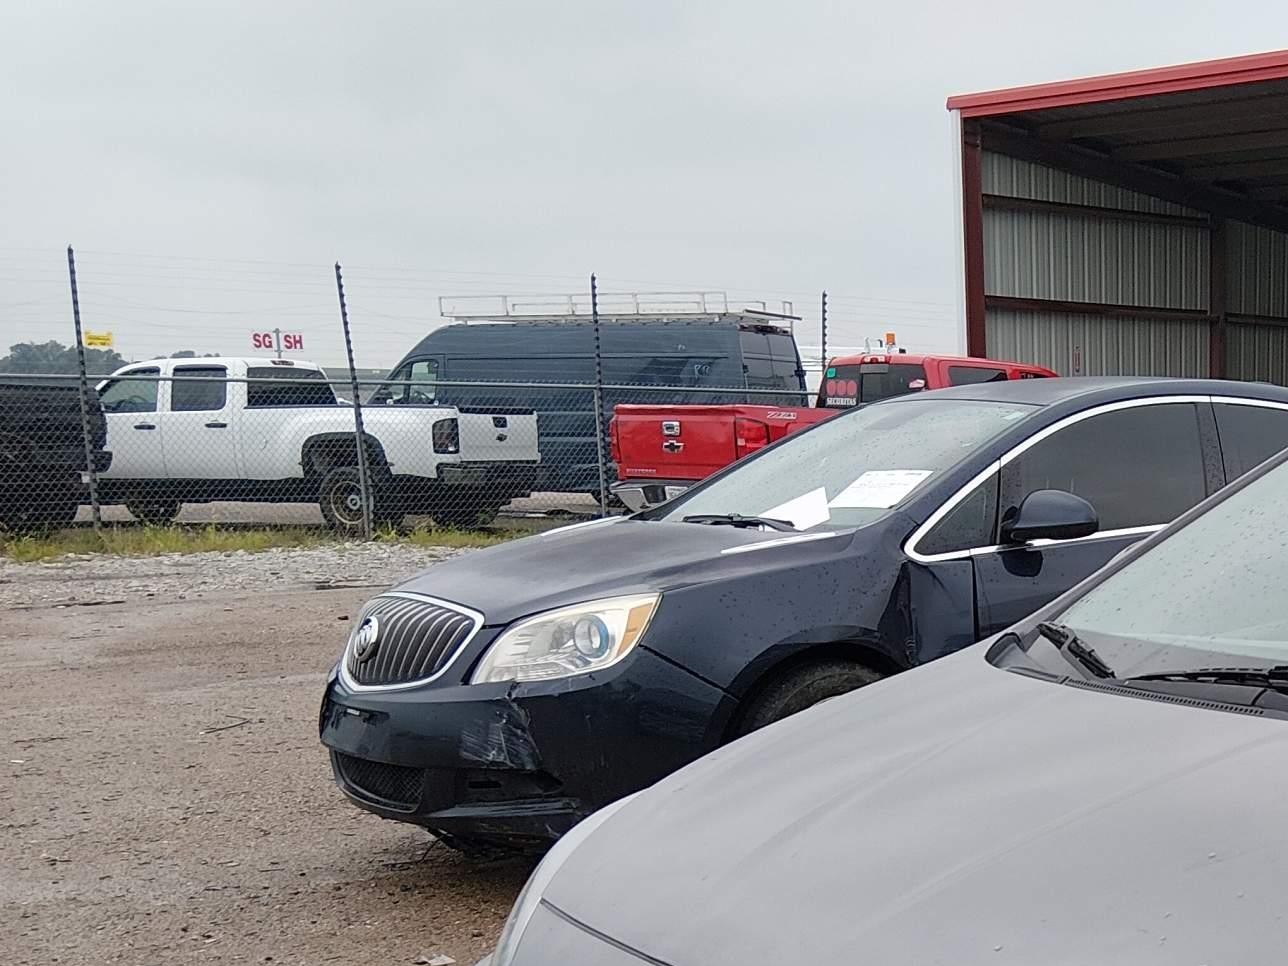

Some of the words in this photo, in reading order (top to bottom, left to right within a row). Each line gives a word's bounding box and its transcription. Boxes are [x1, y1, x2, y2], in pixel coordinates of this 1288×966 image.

[252, 332, 273, 349] SG
[283, 334, 304, 350] SH
[826, 397, 857, 406] SECURITAS
